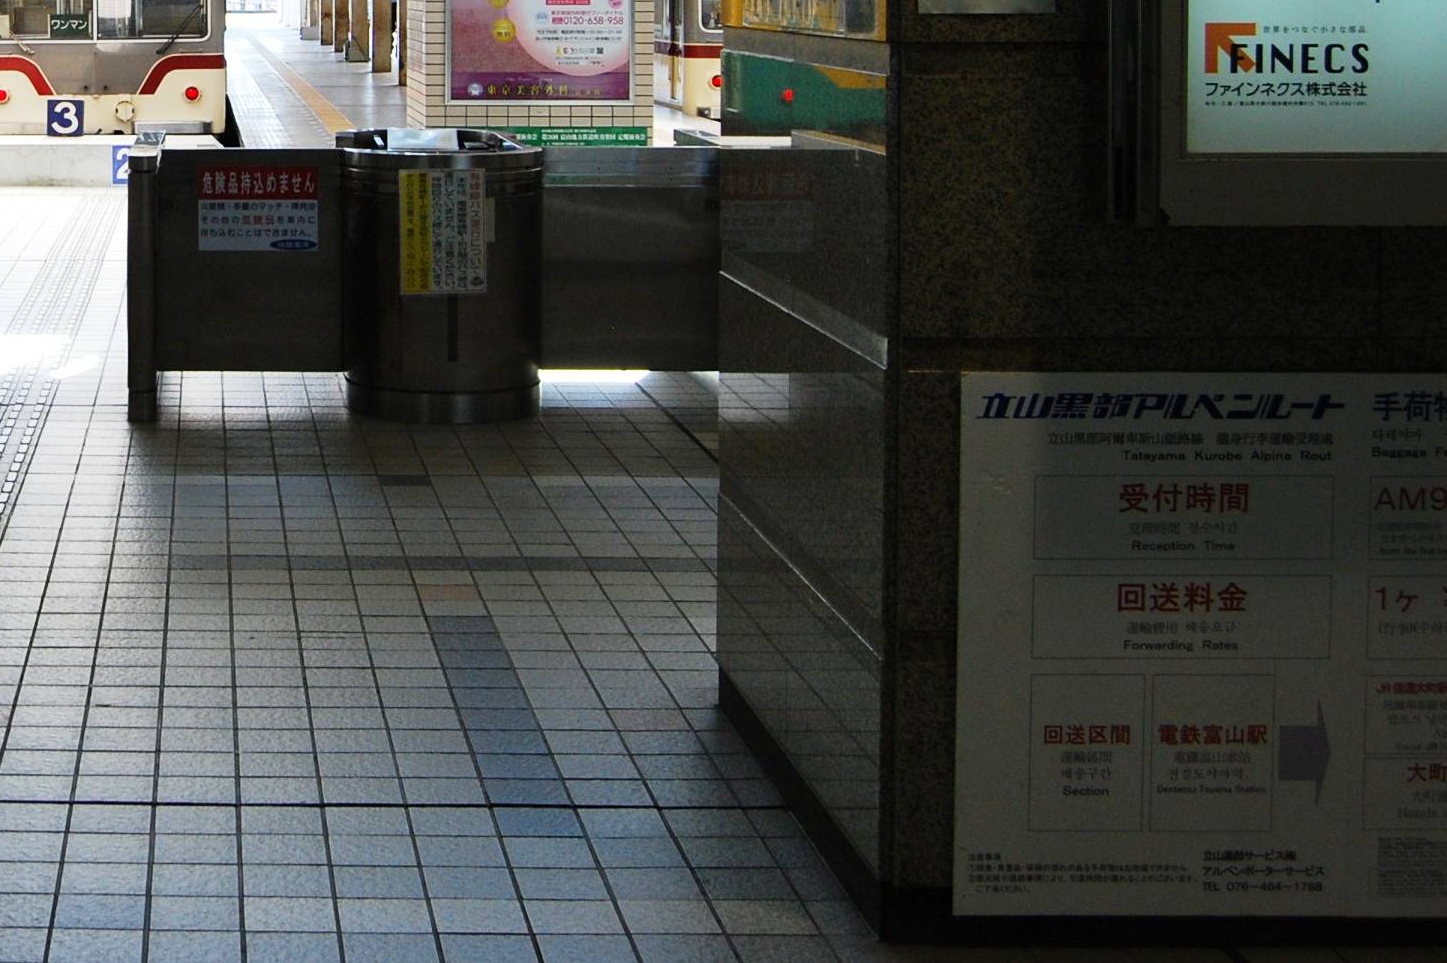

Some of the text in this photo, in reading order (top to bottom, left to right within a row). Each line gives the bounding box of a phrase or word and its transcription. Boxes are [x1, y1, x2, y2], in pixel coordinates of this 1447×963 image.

[50, 18, 88, 31] ワンマン
[1230, 42, 1369, 74] FINECS
[1204, 82, 1368, 97] ファインネクス株式会社
[50, 100, 79, 135] 3
[202, 170, 316, 195] 危険品持込めません
[976, 392, 1345, 421] 立山黒部アルペンルート
[1194, 450, 1242, 460] Kurobe
[1250, 450, 1292, 461] Alpine
[1371, 447, 1428, 459] Baggage
[1119, 483, 1250, 514] 受付時間
[1131, 540, 1236, 552] Reception Time
[1117, 582, 1248, 613] 回送料金
[1123, 639, 1239, 652] Forwarding Rates
[1043, 724, 1268, 746] 回送区間 電鉄富山駅
[1062, 785, 1110, 797] Section
[1203, 881, 1220, 892] TEL
